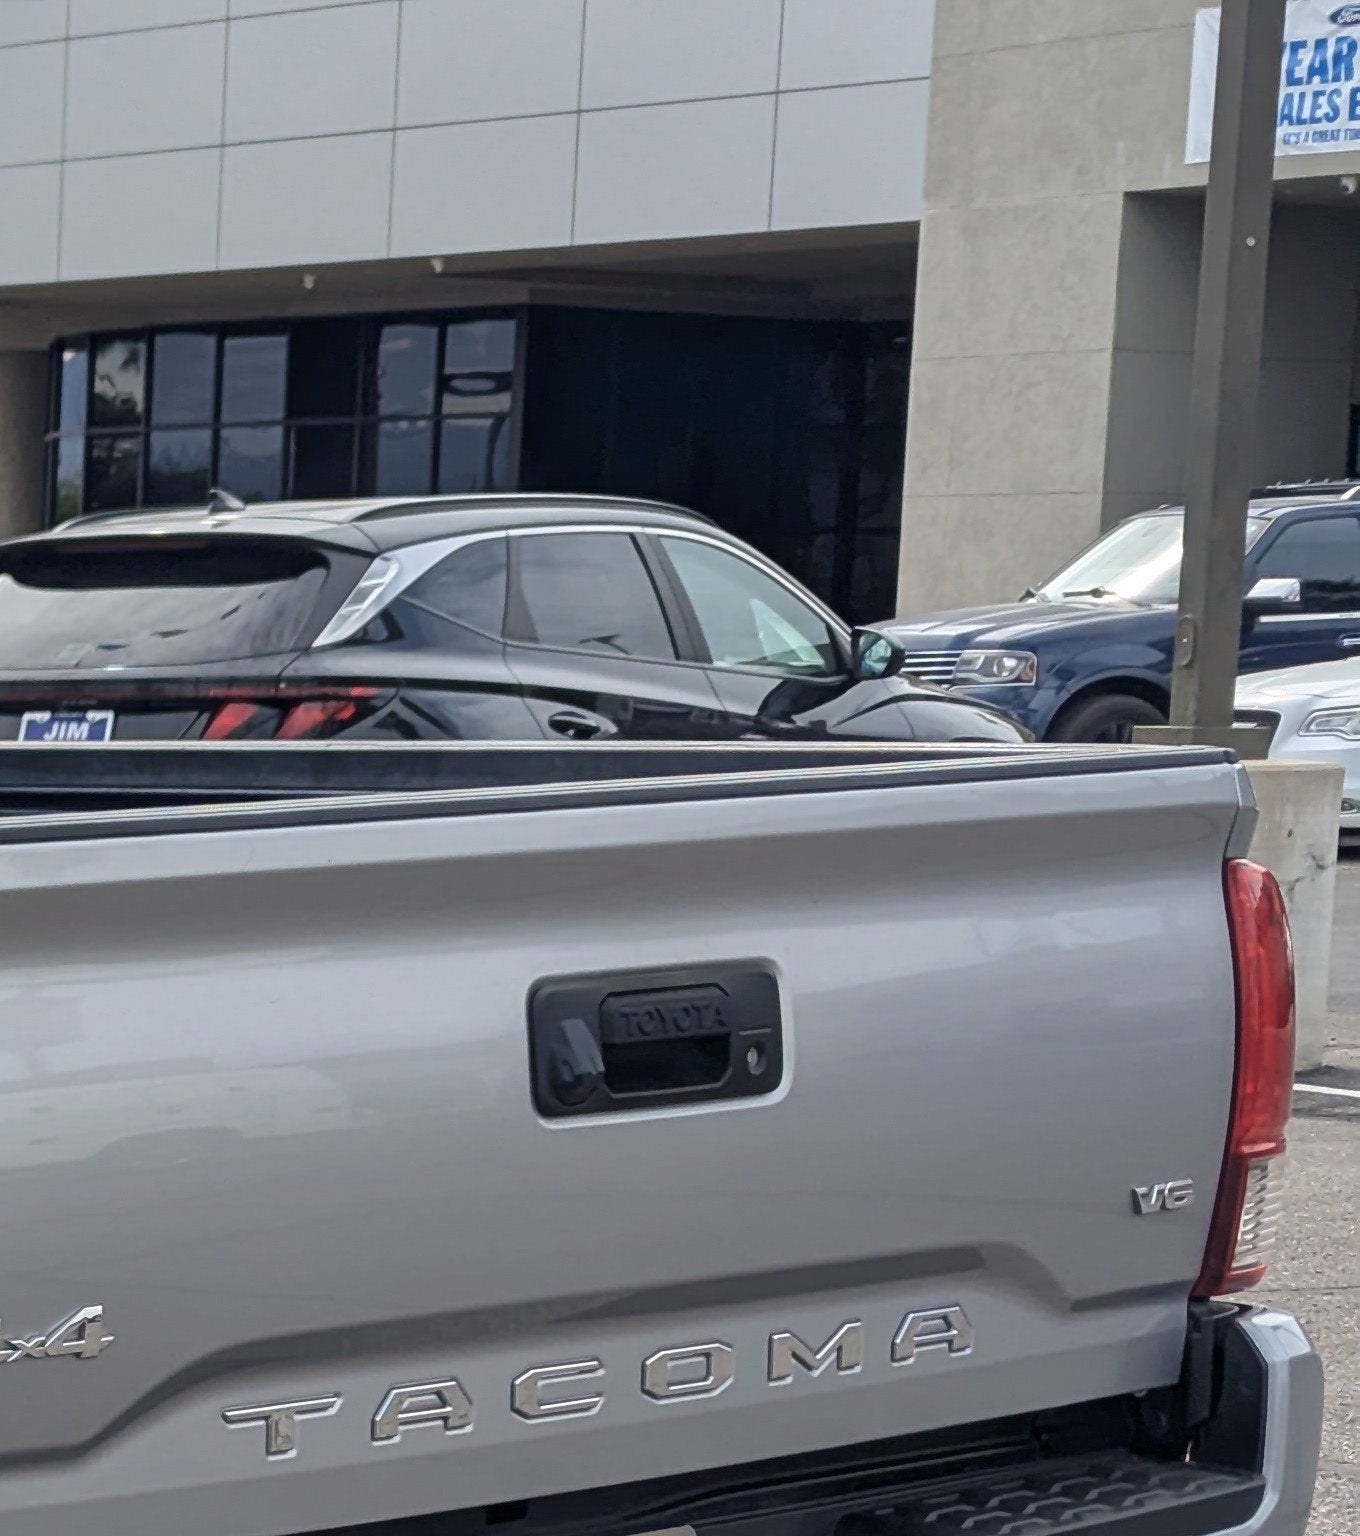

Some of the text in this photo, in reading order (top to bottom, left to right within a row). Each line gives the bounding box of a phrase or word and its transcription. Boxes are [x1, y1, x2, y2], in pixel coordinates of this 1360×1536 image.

[1281, 35, 1357, 87] EAR
[1277, 89, 1342, 126] ALES
[43, 720, 89, 741] JIM
[1131, 1179, 1194, 1215] V6
[220, 1303, 974, 1460] TACOMA
